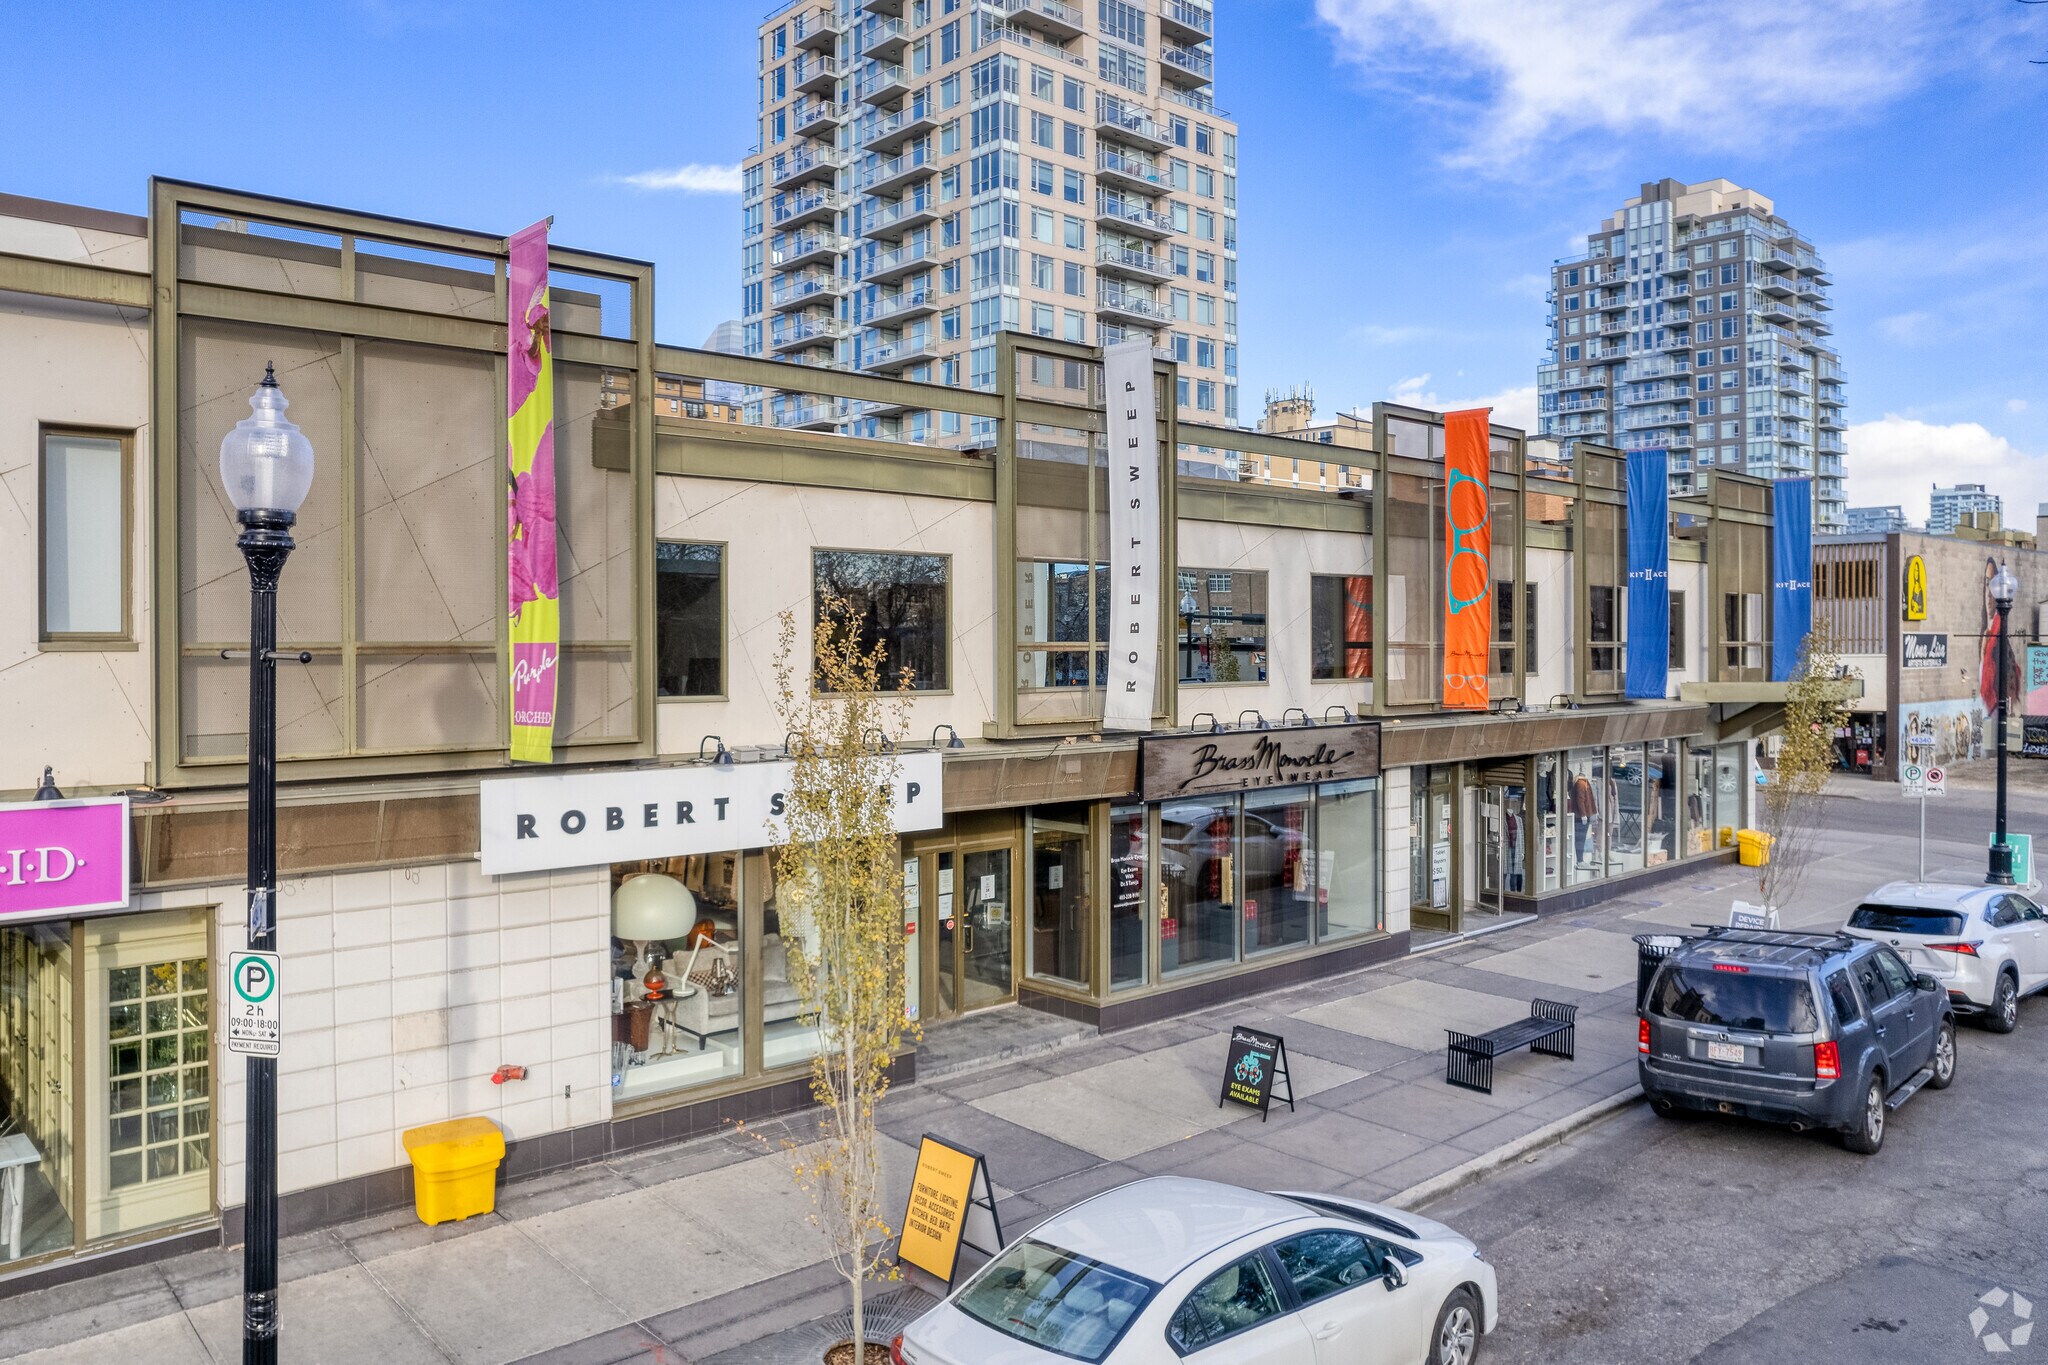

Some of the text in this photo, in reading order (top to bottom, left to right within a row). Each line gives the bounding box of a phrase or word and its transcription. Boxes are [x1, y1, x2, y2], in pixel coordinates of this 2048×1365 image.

[1125, 381, 1141, 693] ROBERT SWEEP
[510, 648, 559, 692] Purple
[1180, 736, 1355, 789] Brass Monocle
[516, 796, 730, 840] ROBERT
[1738, 914, 1765, 926] DEVICE
[231, 1041, 278, 1051] PAYMENT REQUIRED
[1229, 1090, 1259, 1105] AVAILABLE
[1230, 1082, 1261, 1097] EYE EXAMS
